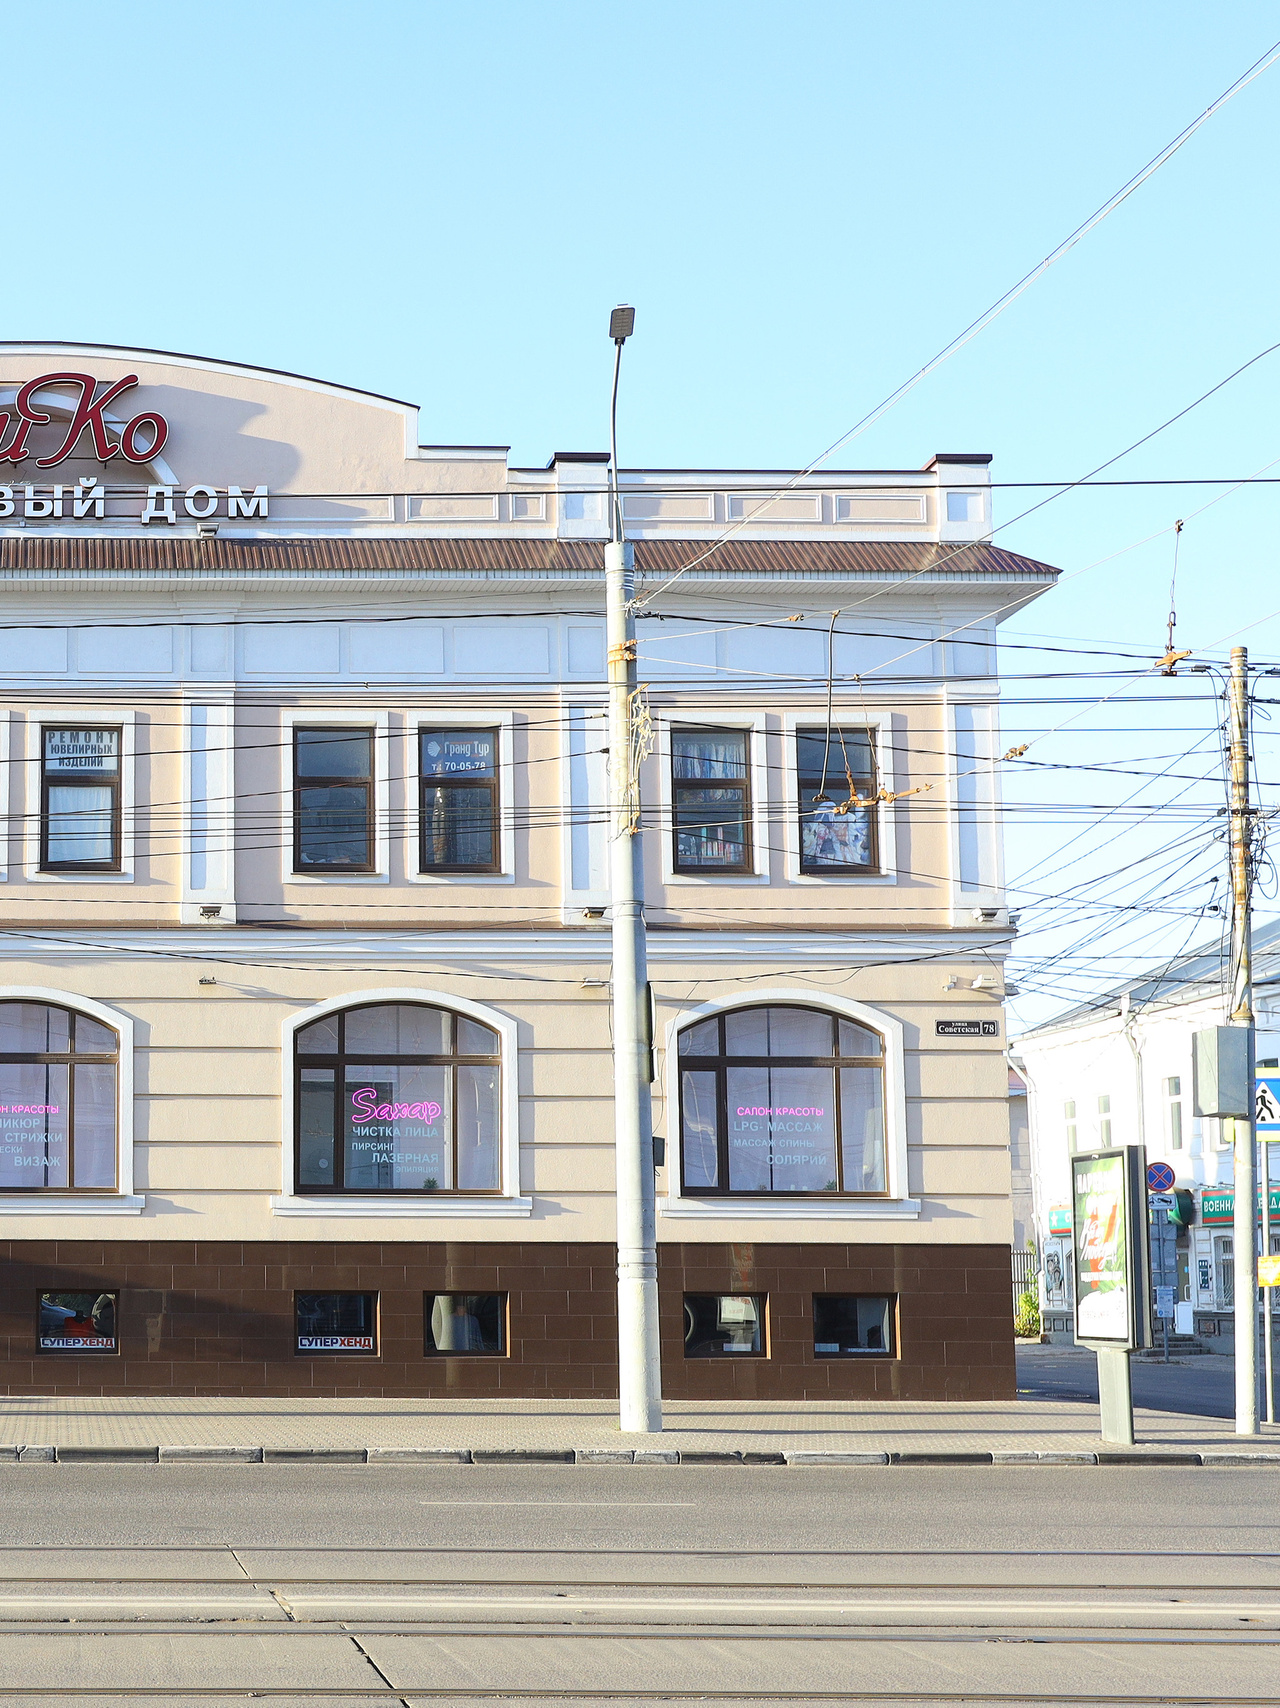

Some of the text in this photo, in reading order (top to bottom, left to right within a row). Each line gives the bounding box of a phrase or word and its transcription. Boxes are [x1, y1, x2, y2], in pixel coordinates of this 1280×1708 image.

[141, 484, 270, 525] ДОМ
[48, 731, 115, 744] РЕМОНТ
[50, 744, 113, 755] ЮВЕЛИРНЫХ
[444, 741, 490, 757] Гранд Тур
[58, 755, 104, 768] ИЗДЕЛИЙ
[444, 761, 486, 771] 70-05-78
[938, 1025, 979, 1033] Советская
[983, 1024, 995, 1033] 78
[11, 1104, 60, 1114] КРАСОТЫ
[736, 1106, 824, 1117] САЛОН КРАСОТЫ
[767, 1121, 823, 1132] МАССАЖ
[5, 1132, 63, 1142] СТРИЖКИ
[352, 1126, 439, 1138] ЧИСТКА ЛИЦА
[351, 1142, 395, 1151] ПИРСИНГ
[733, 1139, 815, 1148] МАССАЖ СПИНЫ
[14, 1156, 61, 1166] ВИЗАЖ
[372, 1153, 439, 1163] ЛАЗЕРНАЯ
[766, 1153, 826, 1165] СОЛЯРИЙ
[396, 1166, 439, 1174] ЭПИЛЯЦИЯ
[41, 1338, 115, 1348] СУПЕРХЕНД
[299, 1337, 372, 1348] СУПЕРХЕНД
